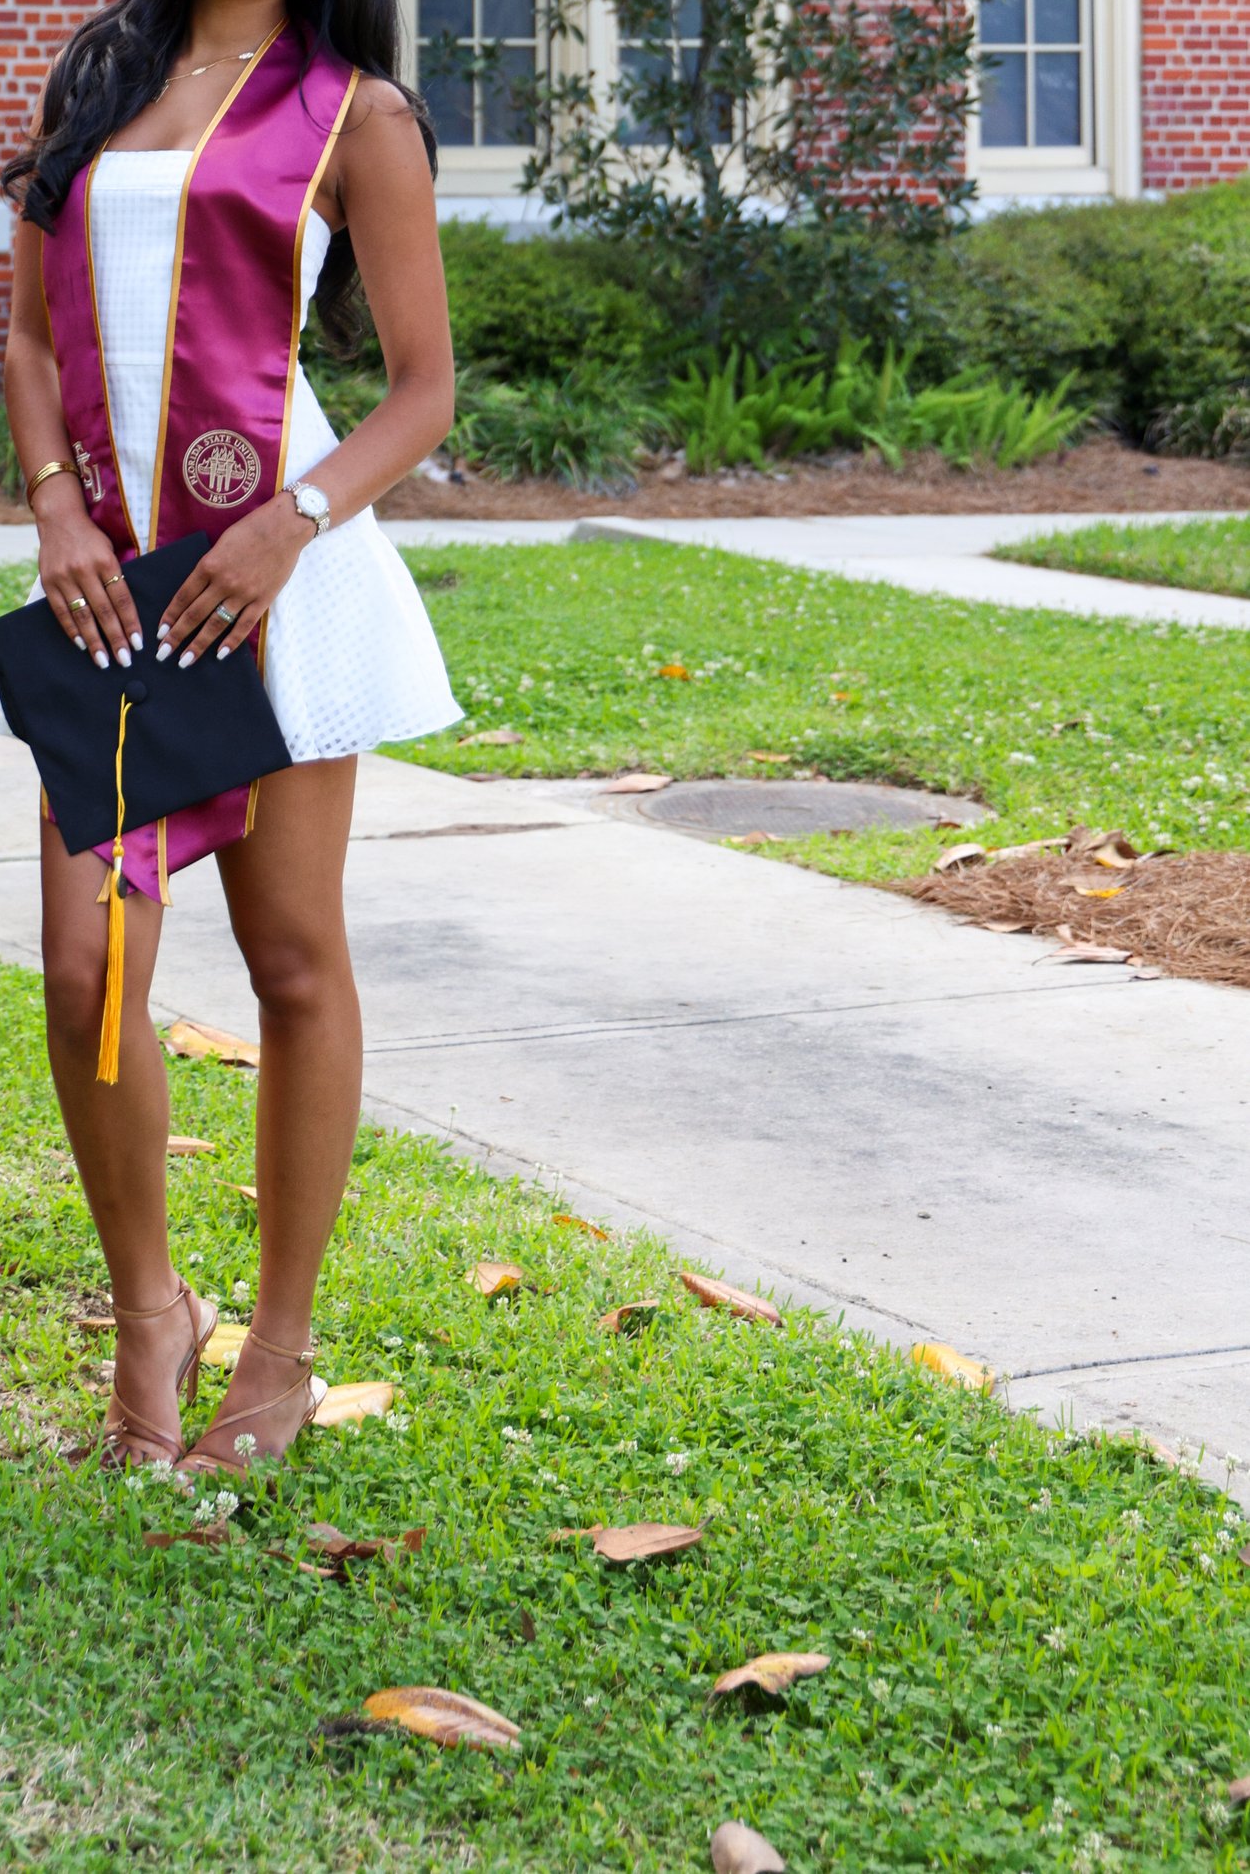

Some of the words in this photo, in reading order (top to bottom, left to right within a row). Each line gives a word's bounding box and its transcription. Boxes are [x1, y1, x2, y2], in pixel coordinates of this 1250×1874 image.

[188, 444, 204, 486] FLORIDA
[203, 434, 232, 446] STATE
[234, 439, 256, 493] UNIVERSITY
[209, 493, 227, 504] 1851
